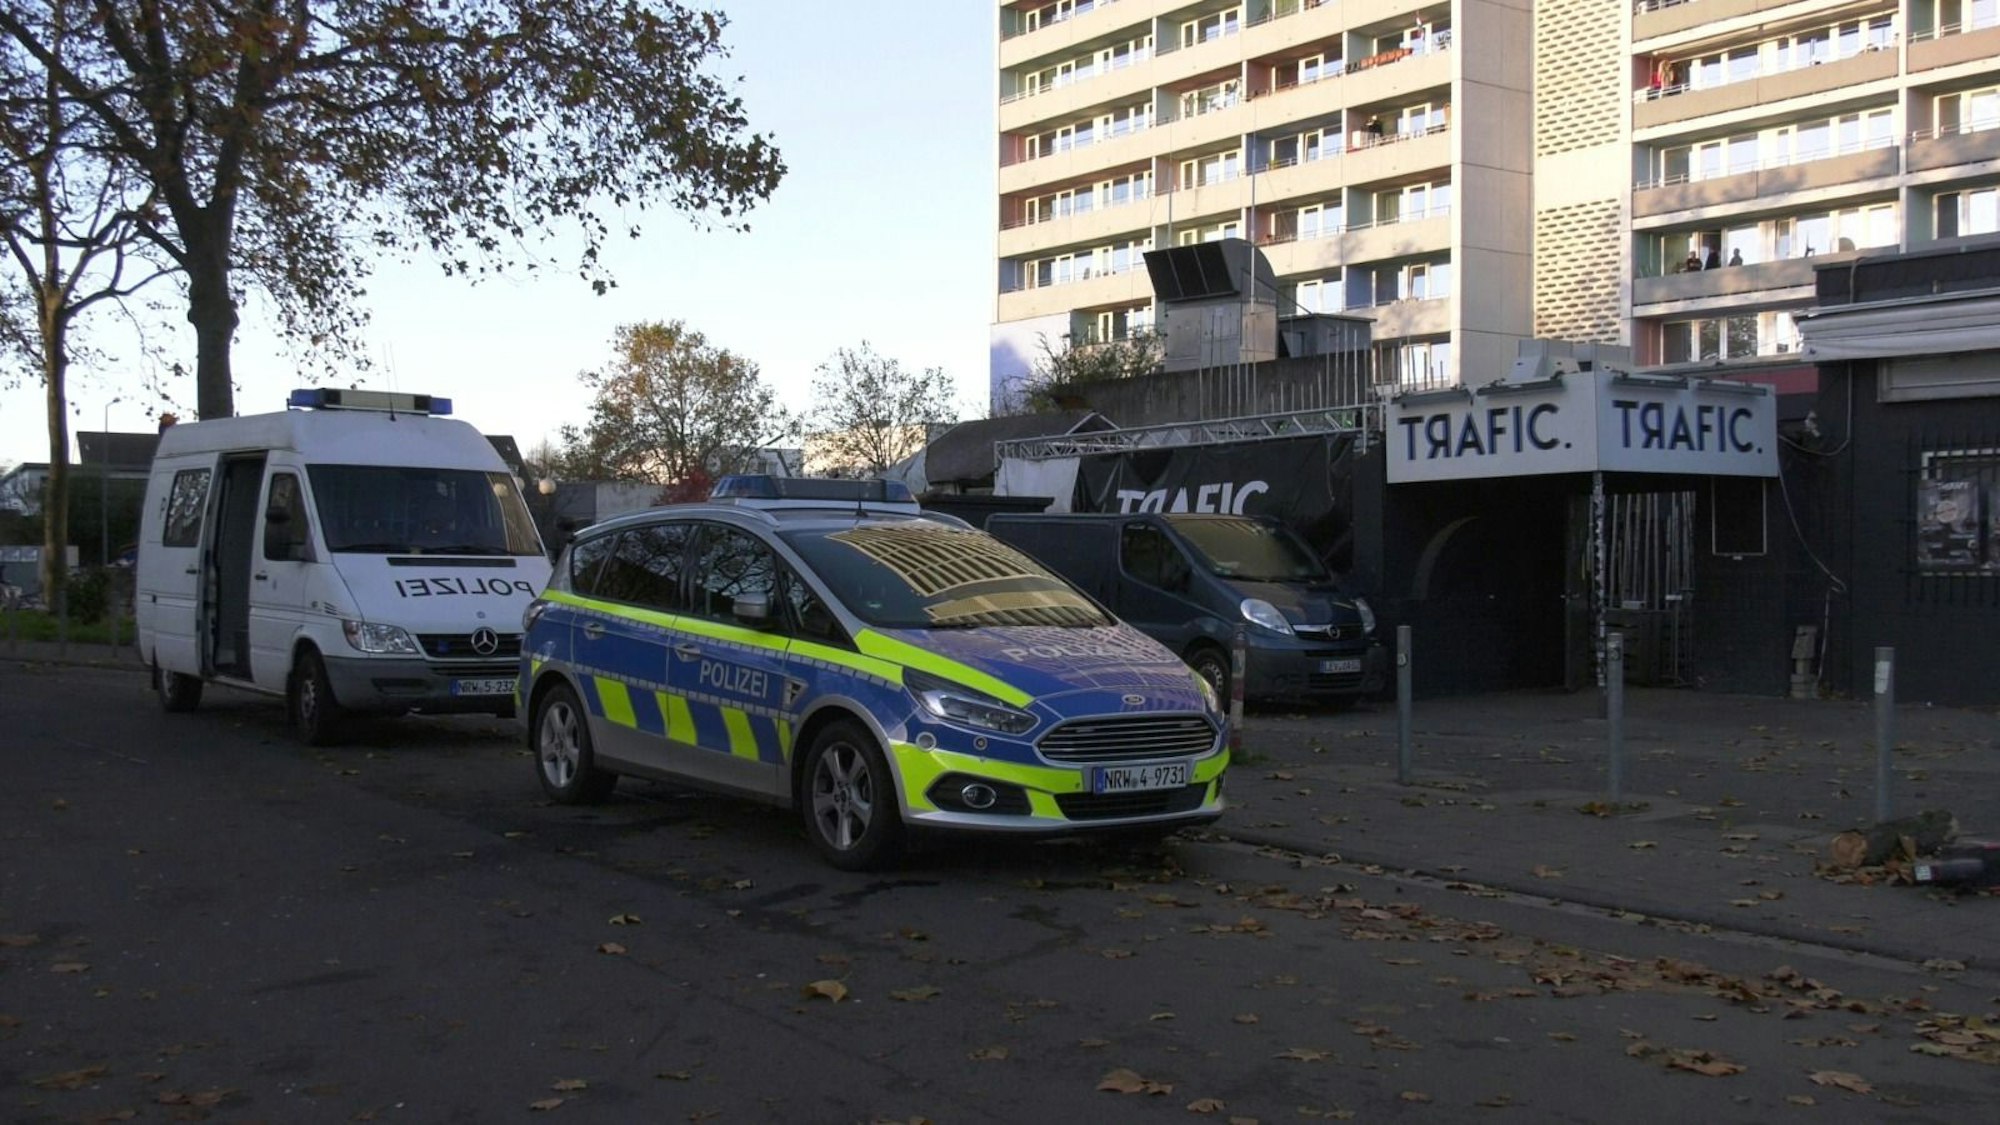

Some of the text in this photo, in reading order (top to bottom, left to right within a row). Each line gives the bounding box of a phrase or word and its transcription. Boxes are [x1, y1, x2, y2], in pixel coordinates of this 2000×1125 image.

[1001, 643, 1156, 662] POLIZ
[458, 680, 479, 693] NRW
[699, 658, 769, 699] POLIZEI
[1104, 769, 1132, 789] NRW
